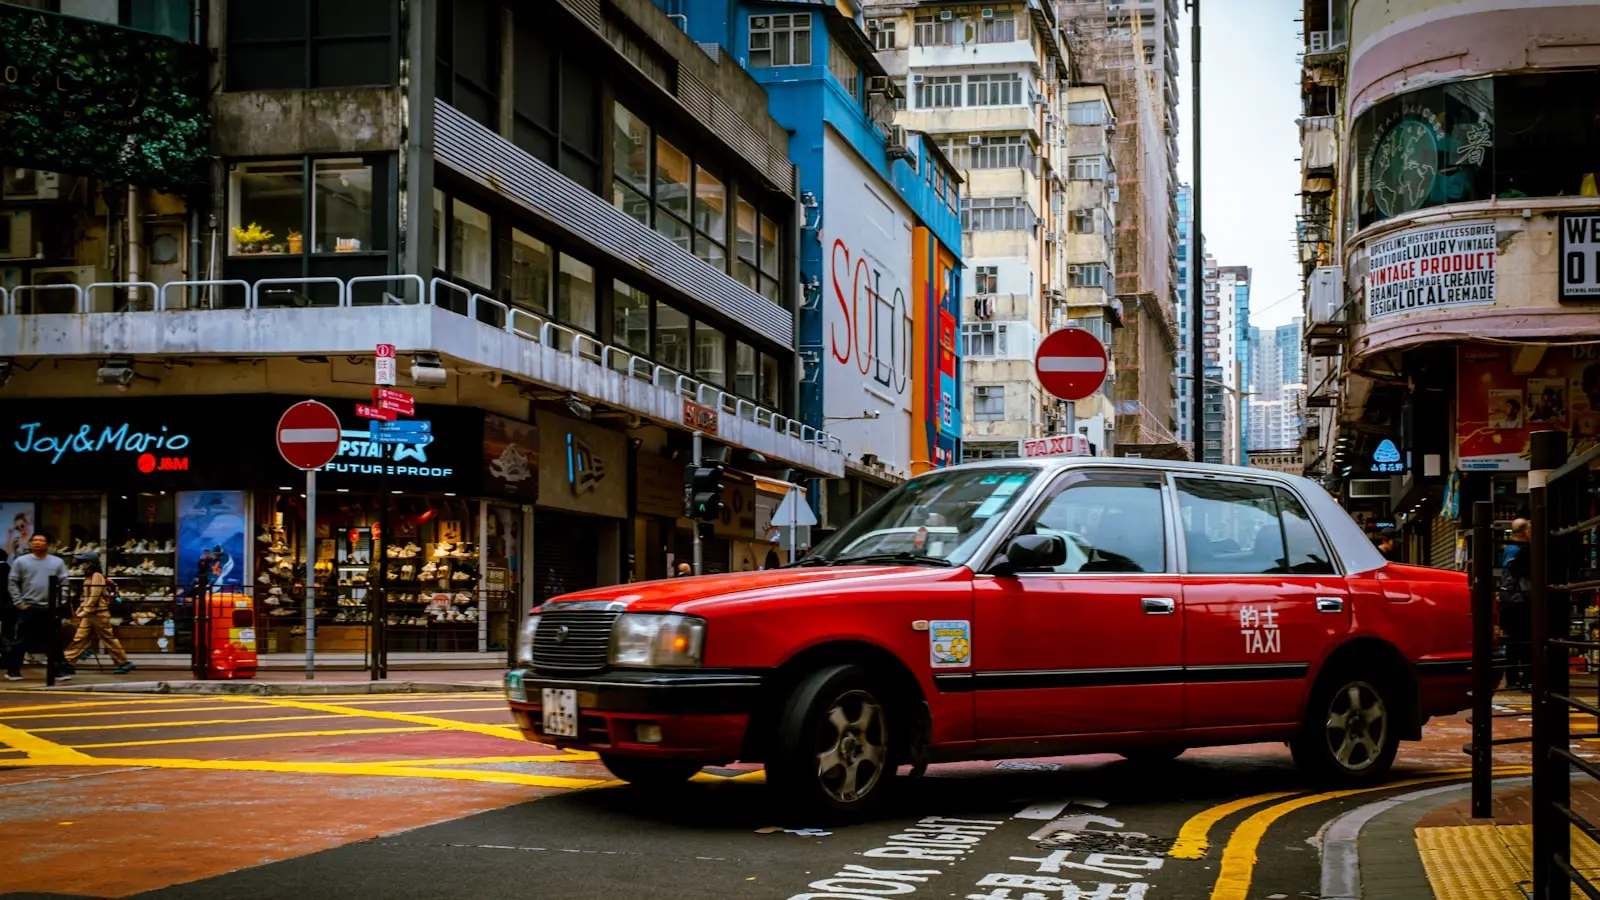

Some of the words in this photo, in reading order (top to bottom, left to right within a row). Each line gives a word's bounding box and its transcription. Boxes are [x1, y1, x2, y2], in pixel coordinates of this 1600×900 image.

[1370, 236, 1408, 257] UPCYCLING
[1408, 231, 1440, 245] HISTORY
[1440, 225, 1496, 239] ACCESSORIES
[1370, 250, 1408, 270] BOUTIQUE
[1407, 239, 1457, 260] LUXURY
[1457, 237, 1494, 252] VINTAGE
[1369, 260, 1416, 287] VINTAGE
[1420, 252, 1495, 276] PRODUCT
[1566, 250, 1600, 285] O
[1370, 283, 1399, 302] BRAND
[1444, 270, 1495, 288] CREATIVE
[1370, 297, 1397, 316] DESIGN
[1398, 285, 1446, 309] LOCAL
[1447, 286, 1494, 302] REMADE
[832, 239, 907, 395] SOLO
[14, 422, 190, 464] Joy&Mario
[1024, 436, 1073, 457] TAXI
[157, 457, 189, 471] J&M
[1240, 605, 1279, 628] 的士
[1241, 629, 1281, 654] TAXI
[863, 816, 1004, 861] RIGHT
